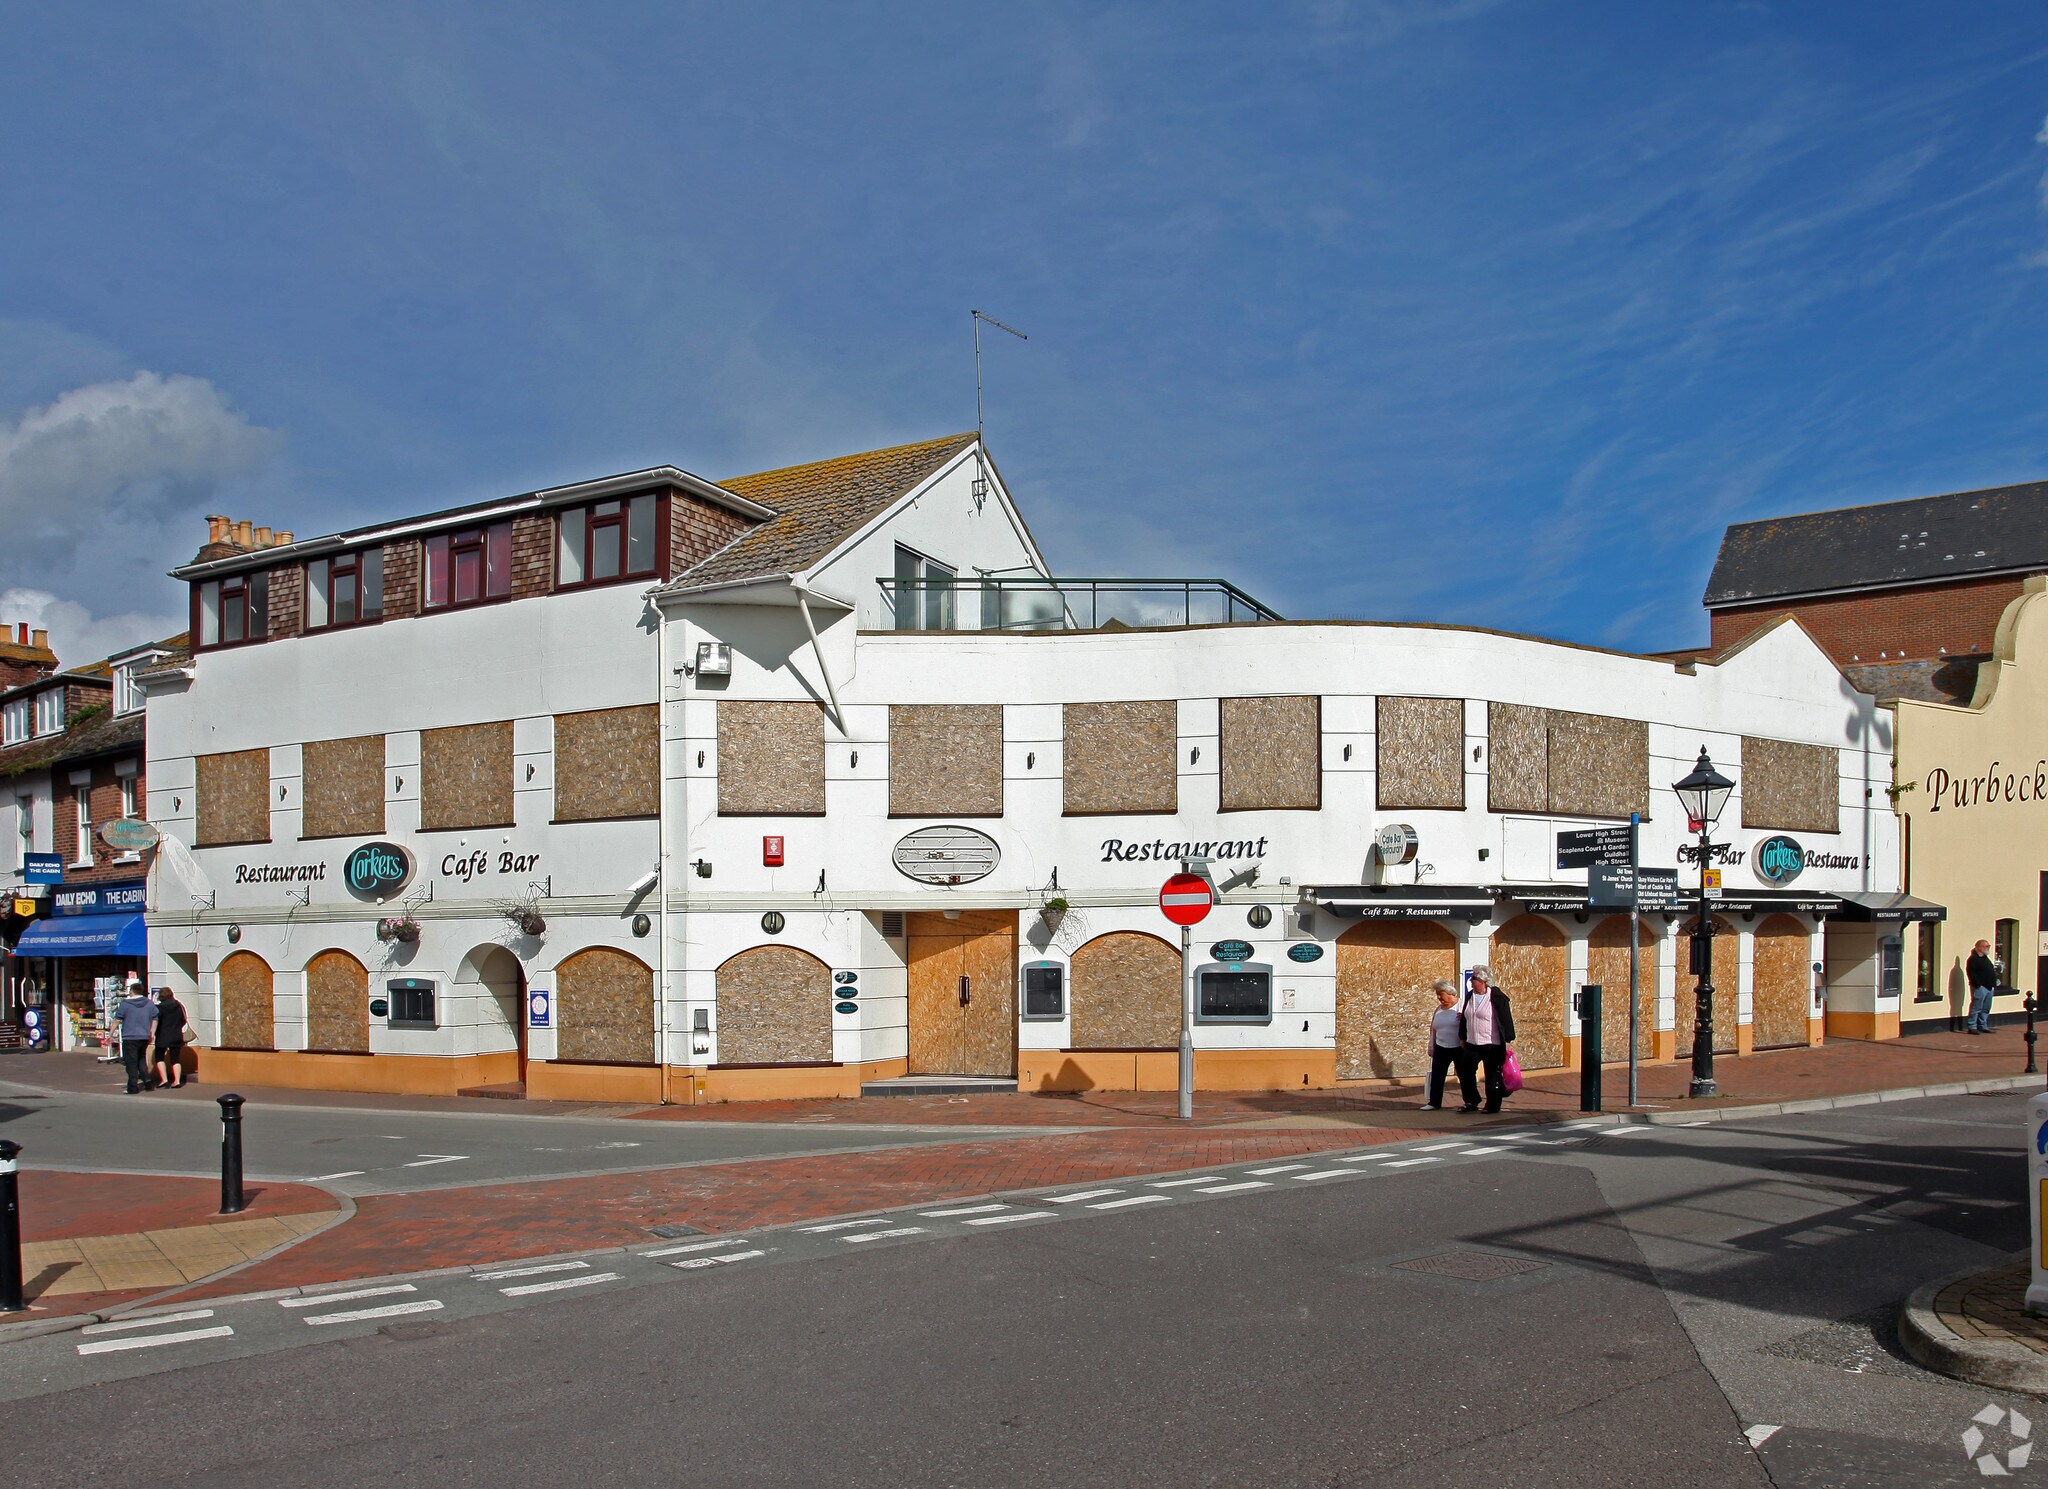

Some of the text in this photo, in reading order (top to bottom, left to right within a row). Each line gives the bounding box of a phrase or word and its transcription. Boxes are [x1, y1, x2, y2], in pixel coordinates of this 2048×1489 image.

[1926, 759, 2048, 813] Purbeck
[1394, 834, 1402, 842] Bar
[1100, 836, 1268, 862] Restaurant
[1380, 845, 1403, 855] Restaurant
[1558, 846, 1584, 854] Scaplens
[1718, 850, 1746, 865] Bar
[1763, 840, 1800, 880] Corkers
[234, 860, 327, 884] Restaurant
[350, 848, 403, 890] Corkers
[441, 850, 540, 884] Café Bar
[56, 891, 96, 906] DAILY ECHO
[106, 889, 146, 904] THE CABIN
[1362, 907, 1382, 918] Café
[1406, 908, 1450, 916] Restaurant
